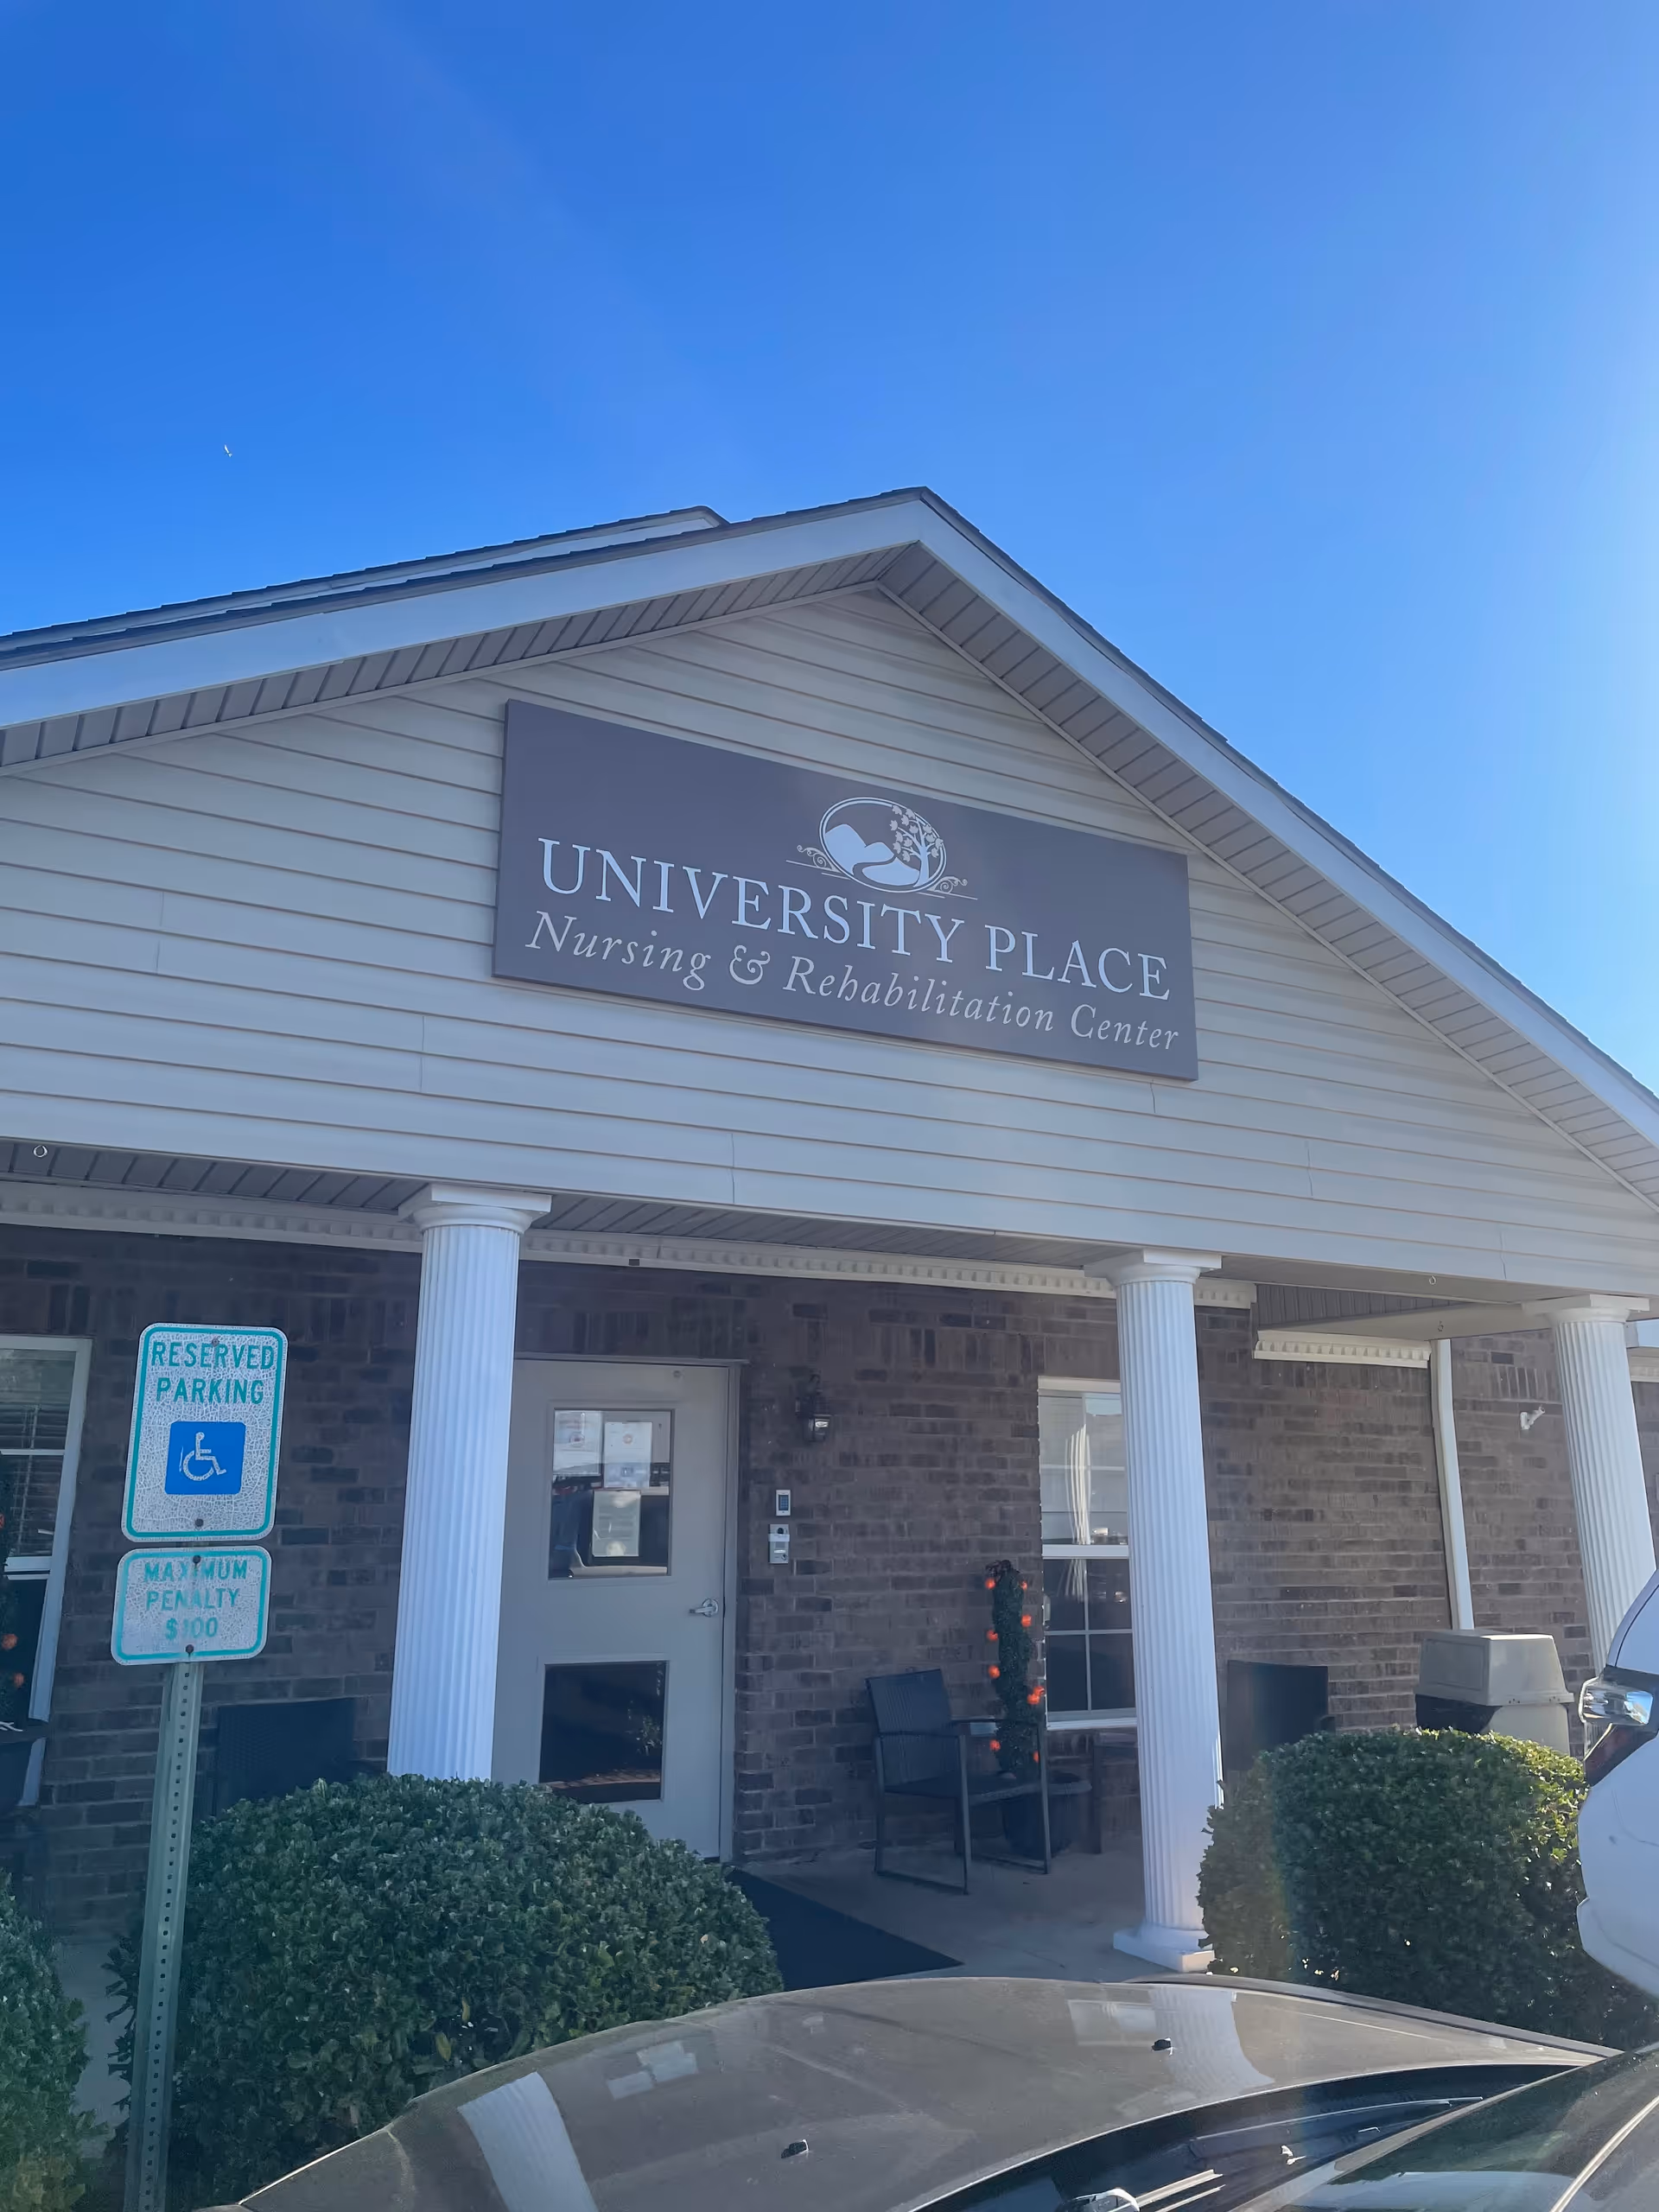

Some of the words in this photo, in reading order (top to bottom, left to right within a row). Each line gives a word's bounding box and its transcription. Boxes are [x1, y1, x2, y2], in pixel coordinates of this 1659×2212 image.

[538, 837, 964, 963] UNIVERSITY
[985, 924, 1170, 1001] PLACE
[525, 910, 711, 991] Nursing
[729, 944, 771, 985] &
[782, 956, 1054, 1032] Rehabilitation
[1071, 1004, 1179, 1050] Center
[151, 1341, 275, 1370] RESERVED
[156, 1377, 264, 1405] PARKING
[144, 1560, 247, 1582] MAXIMUM
[146, 1587, 240, 1611] PENALTY
